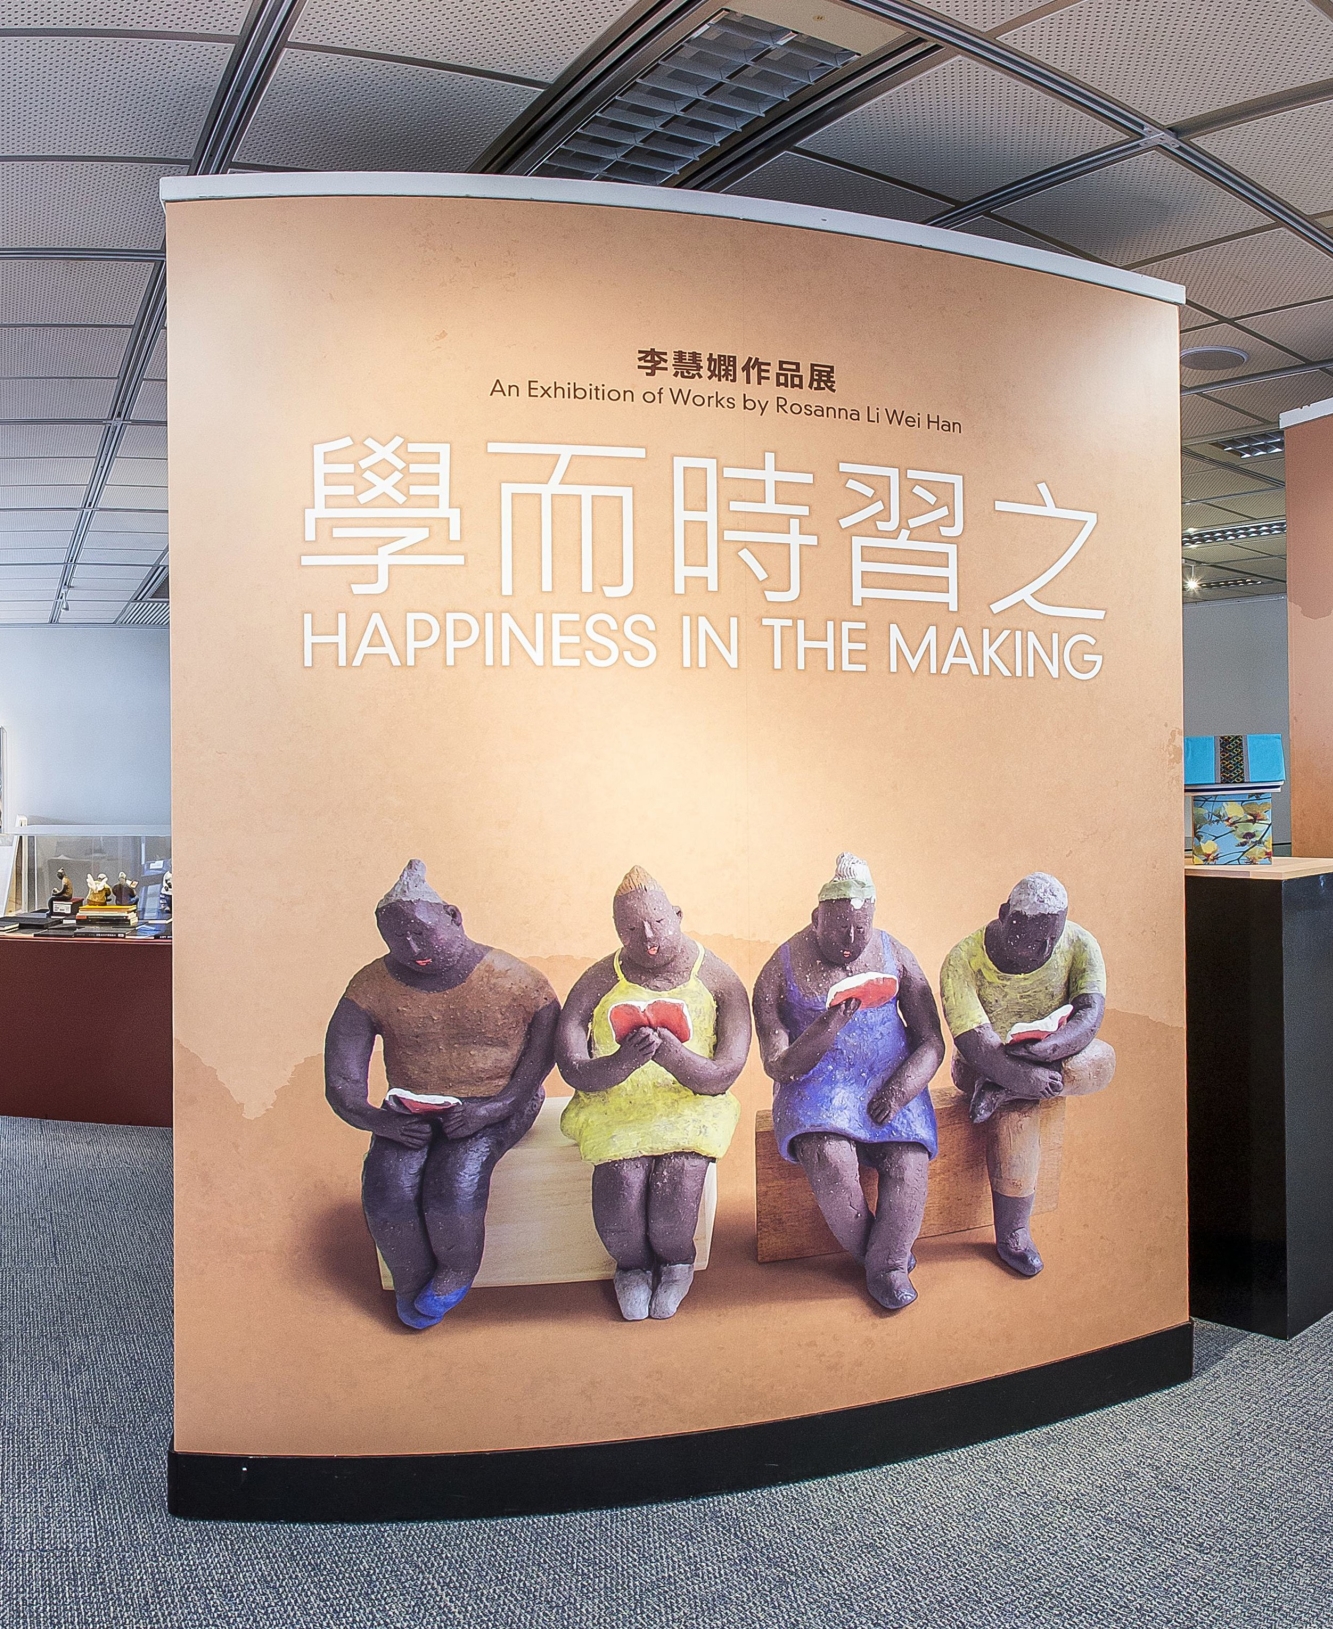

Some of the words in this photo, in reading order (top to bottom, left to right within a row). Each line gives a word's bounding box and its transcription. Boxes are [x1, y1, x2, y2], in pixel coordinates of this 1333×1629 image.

[637, 348, 836, 393] 李慧嫻作品展
[490, 379, 519, 397] An
[528, 380, 634, 402] Exhibition
[642, 387, 663, 404] of
[669, 388, 735, 409] Works
[743, 394, 769, 416] by
[776, 397, 860, 421] Rosanna
[867, 406, 880, 424] Li
[885, 408, 921, 428] Wei
[927, 414, 962, 434] Han
[300, 434, 1106, 621] 學而時習之
[303, 612, 657, 668] HAPPINESS
[682, 615, 738, 669] IN
[762, 618, 867, 672] THE
[889, 623, 1103, 681] MAKING
